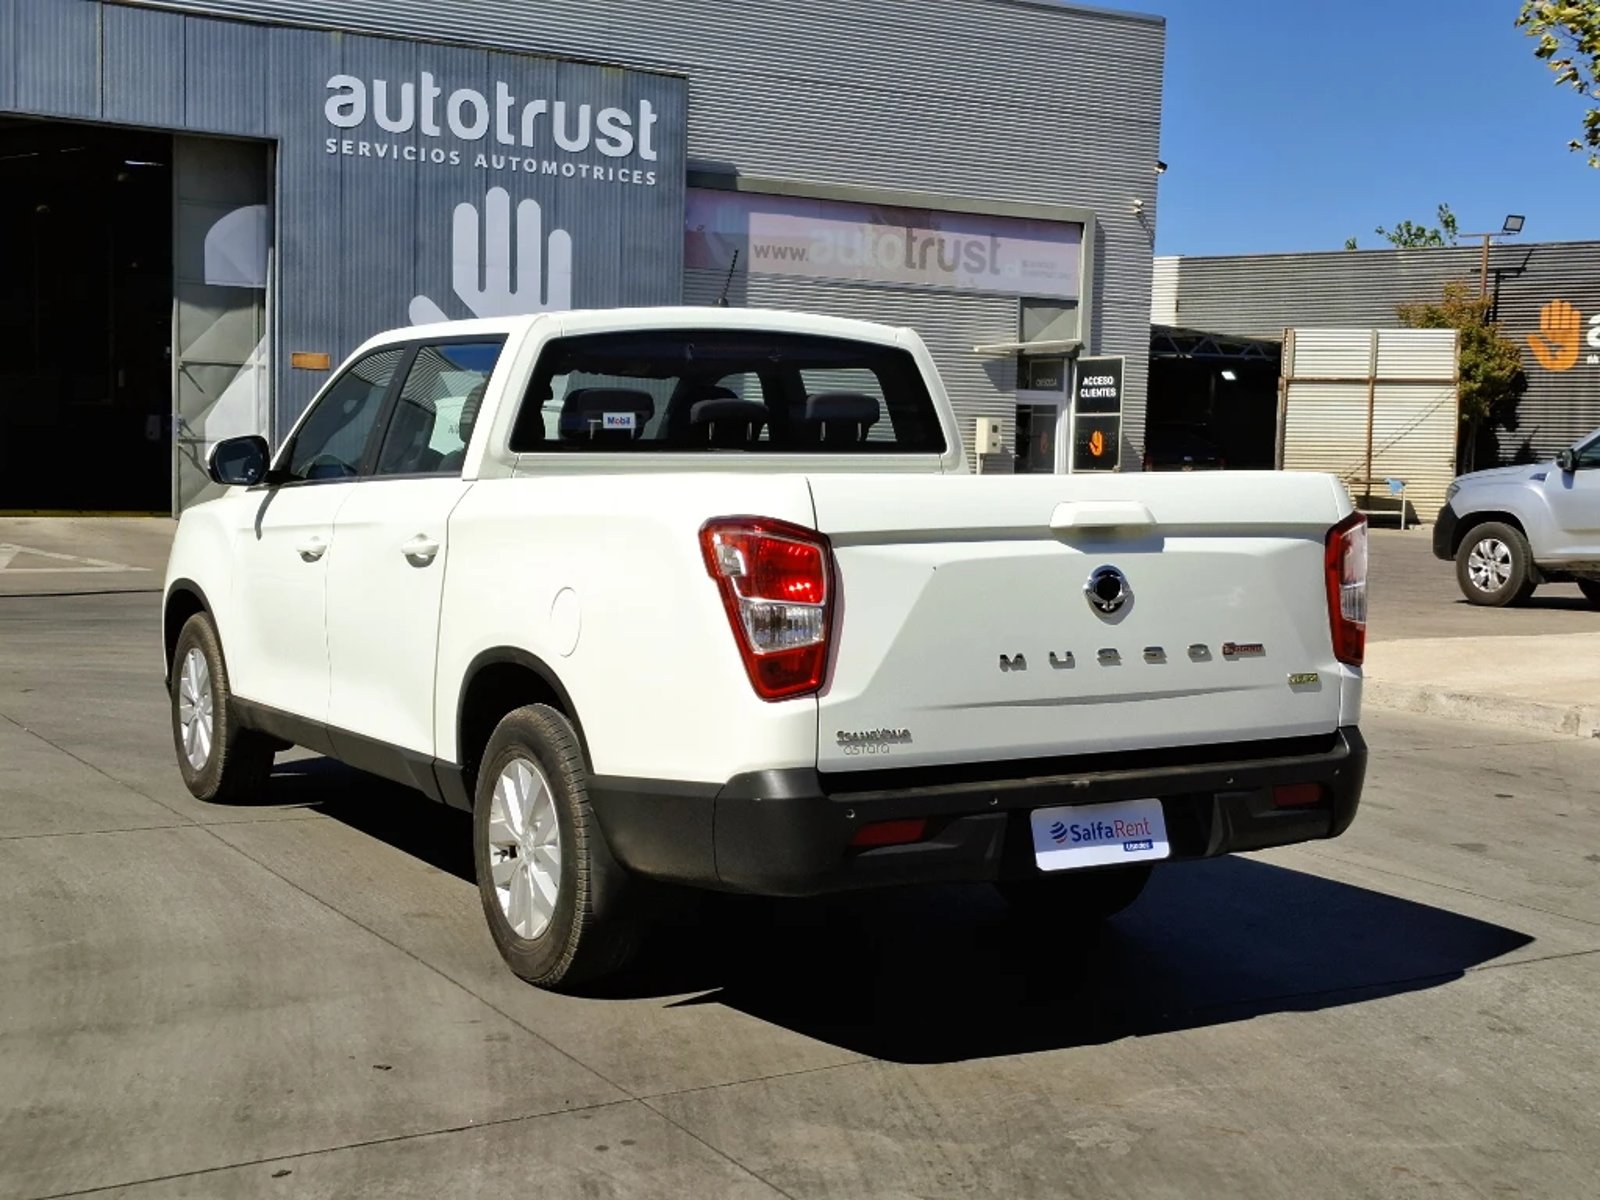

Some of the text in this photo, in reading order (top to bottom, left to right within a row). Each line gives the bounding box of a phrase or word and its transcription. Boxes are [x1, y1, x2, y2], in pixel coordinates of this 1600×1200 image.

[324, 71, 657, 161] autotrust
[325, 138, 657, 186] SERVICIOS AUTOMOTRICES
[1082, 375, 1114, 386] ACCESO
[1080, 387, 1117, 398] CLIENTES
[607, 416, 631, 426] Mobil
[1069, 817, 1152, 842] SalfaRent
